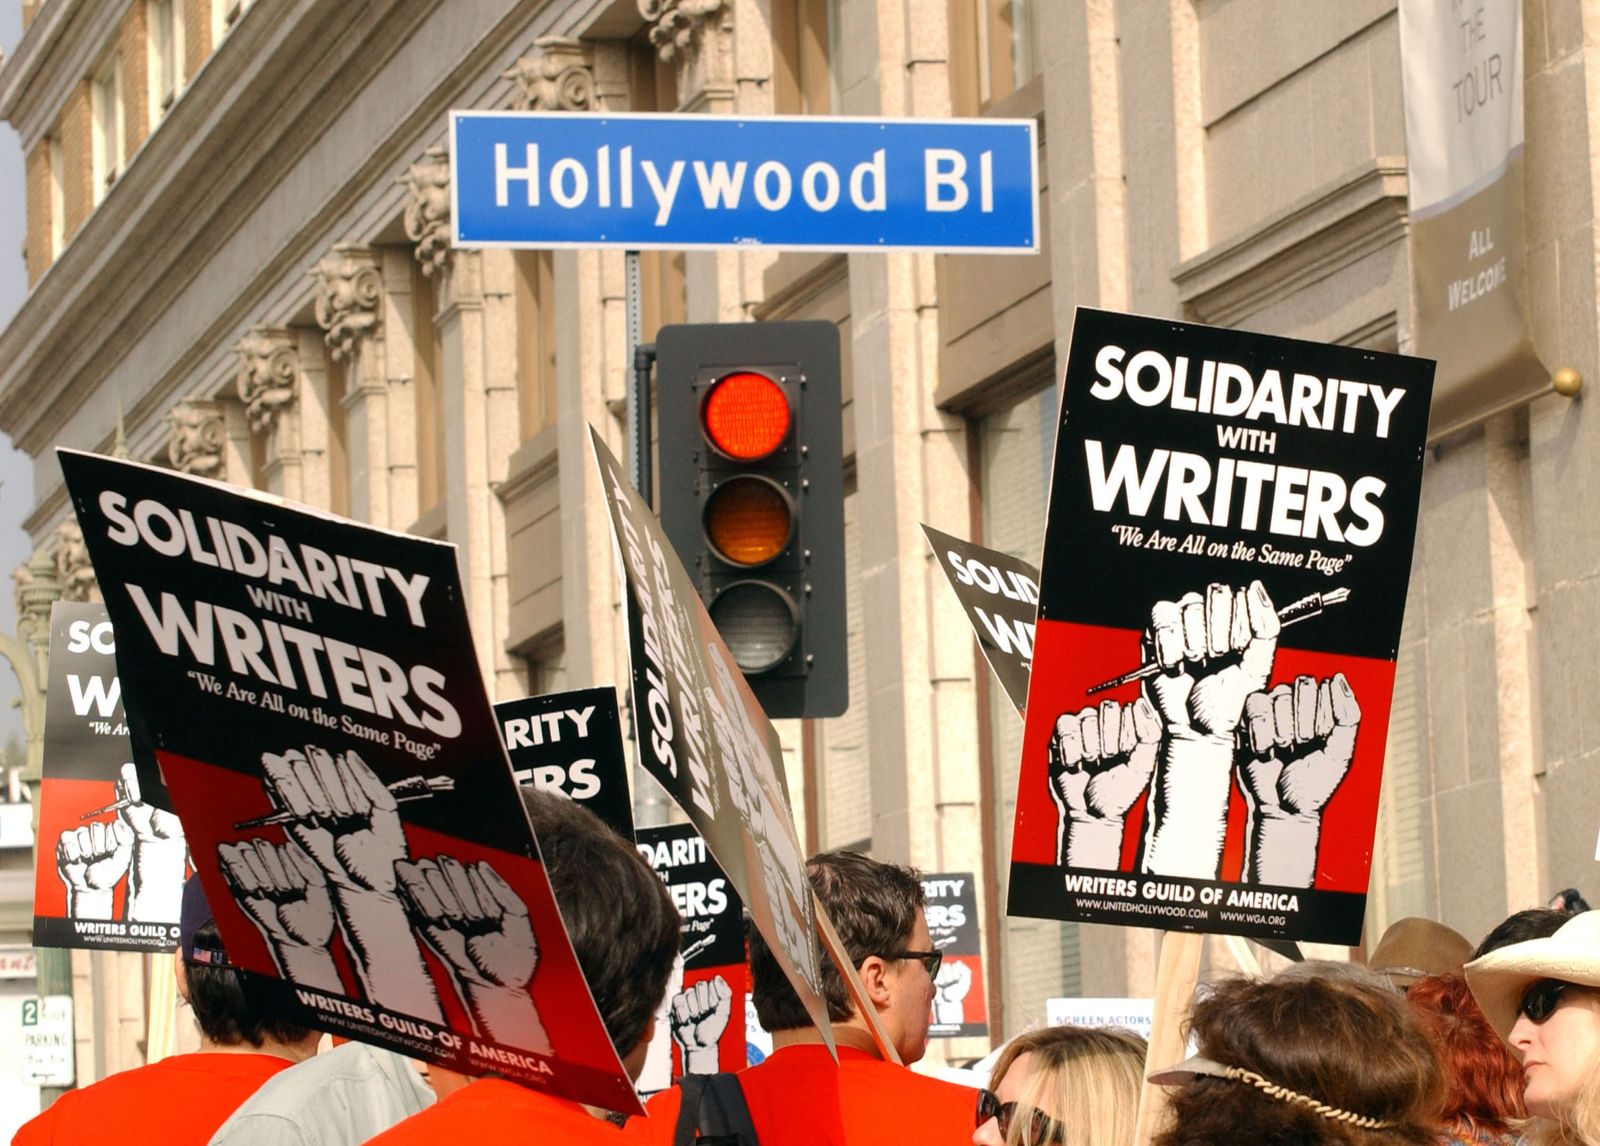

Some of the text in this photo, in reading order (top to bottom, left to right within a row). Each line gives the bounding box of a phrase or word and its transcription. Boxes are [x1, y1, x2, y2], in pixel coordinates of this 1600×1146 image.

[1453, 54, 1502, 123] TOUR
[494, 143, 993, 226] Hollywood Bl
[1090, 345, 1406, 438] SOLIDARITY
[1216, 424, 1277, 454] WITH
[1084, 439, 1387, 547] WRITERS
[99, 491, 430, 627] SOLIDARITY
[1144, 529, 1177, 551] Are
[1177, 534, 1206, 555] All
[1207, 542, 1228, 558] on
[1231, 541, 1256, 561] the
[1258, 543, 1304, 567] Same
[246, 584, 313, 623] WITH
[125, 583, 462, 738] WRITERS
[226, 681, 257, 705] Are
[260, 691, 285, 713] All
[288, 703, 310, 720] on
[312, 707, 338, 729] the
[341, 715, 389, 745] Same
[1065, 874, 1300, 912] WRITERS GUILD OF AMERICA
[1076, 899, 1286, 926] WWW.UNITEDHOLLYWOOD.COM WWW.WGA.ORG
[74, 921, 126, 935] WRITERS
[129, 924, 167, 937] GUILD
[25, 1002, 36, 1023] 2
[296, 990, 554, 1075] WRITERS GUILD OF AMERICA
[26, 1033, 67, 1047] PARKING
